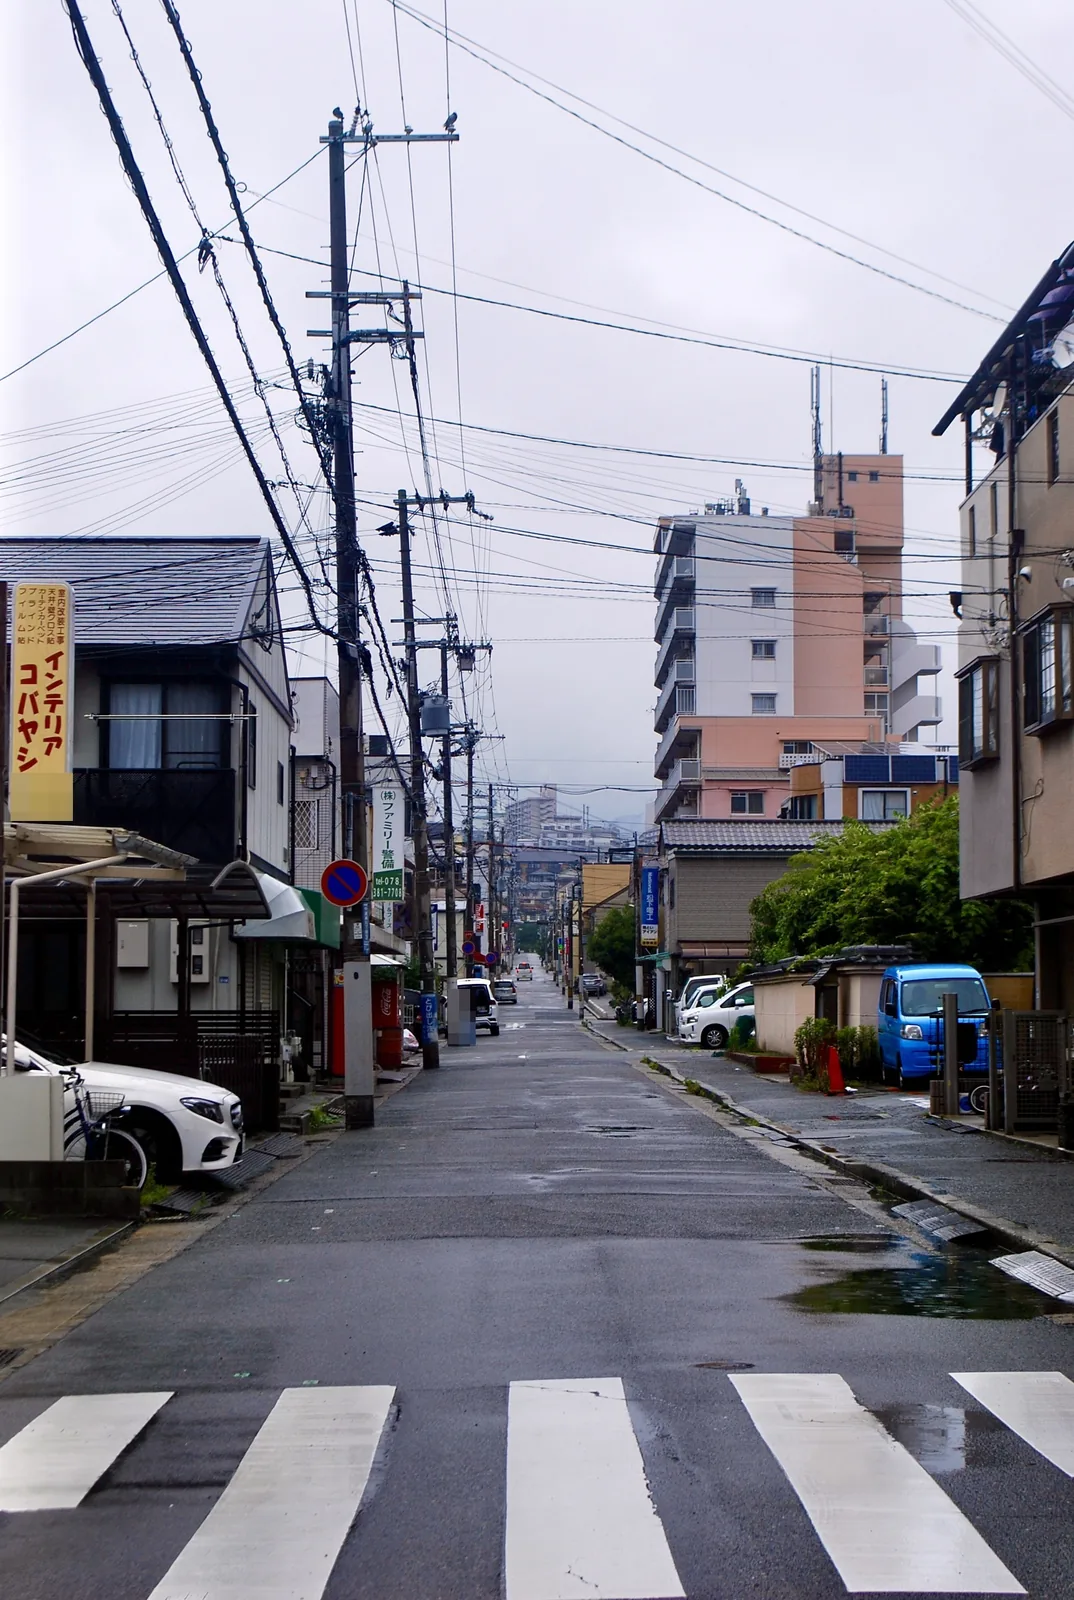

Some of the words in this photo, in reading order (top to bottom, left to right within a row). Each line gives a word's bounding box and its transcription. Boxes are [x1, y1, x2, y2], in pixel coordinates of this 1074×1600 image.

[17, 587, 27, 645] フィルム貼
[27, 587, 37, 644] ブラインド
[37, 588, 46, 644] カーテン・カーペット
[46, 588, 56, 645] 天井・壁クロス貼
[57, 588, 66, 645] 室内改装工事
[17, 664, 39, 773] コバヤシ
[43, 650, 64, 756] インテリア
